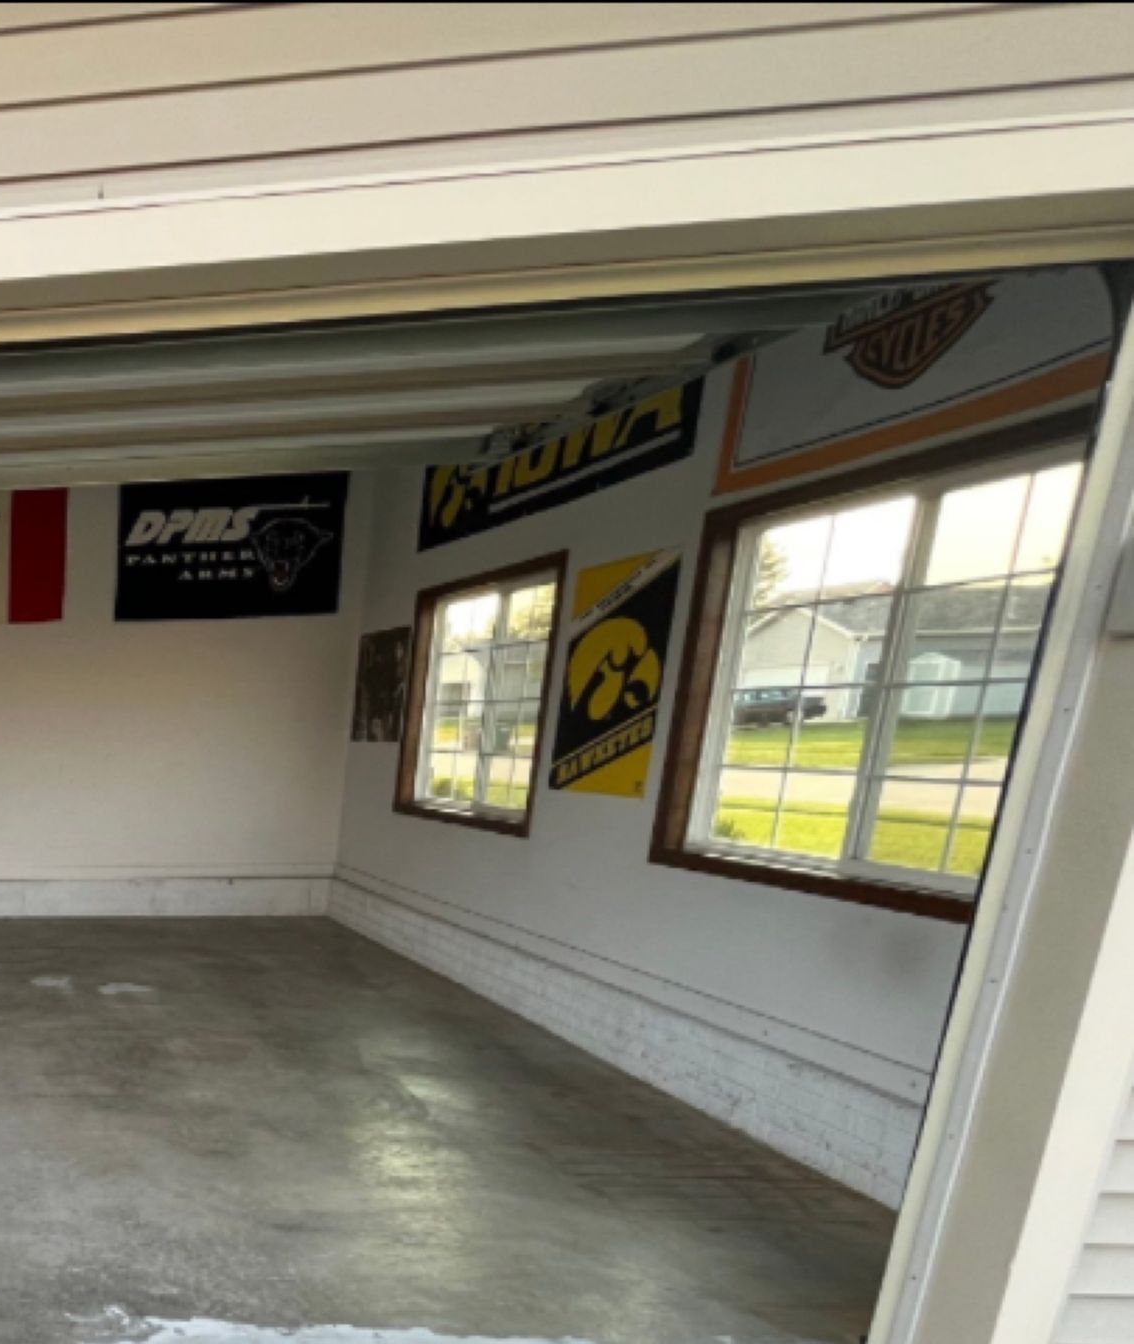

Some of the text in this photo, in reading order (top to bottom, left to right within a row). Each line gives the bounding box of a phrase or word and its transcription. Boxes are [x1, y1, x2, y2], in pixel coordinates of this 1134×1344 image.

[125, 507, 260, 547] DPMS
[125, 548, 256, 566] PANTHER
[178, 567, 254, 581] ARMS
